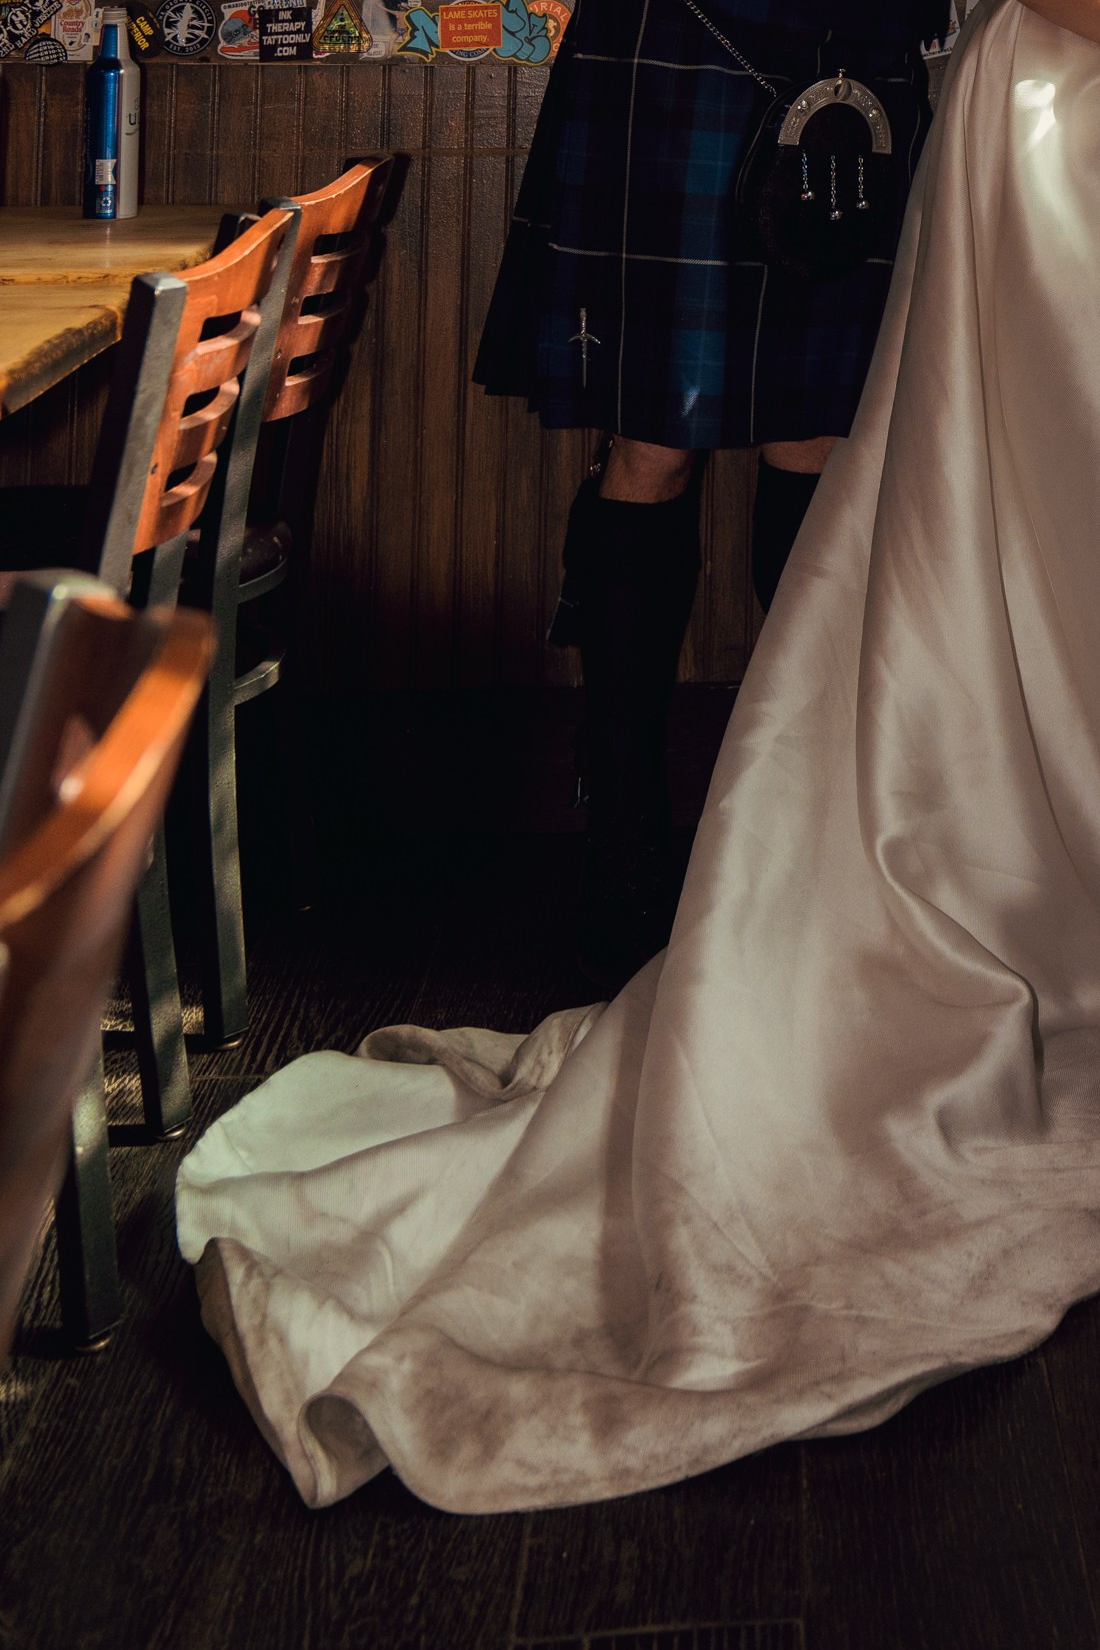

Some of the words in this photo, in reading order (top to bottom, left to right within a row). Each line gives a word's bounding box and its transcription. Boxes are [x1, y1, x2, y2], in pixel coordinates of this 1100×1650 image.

[278, 10, 292, 20] INK
[443, 10, 466, 20] LAME
[468, 9, 498, 19] SKATES
[59, 20, 85, 29] Country
[136, 16, 154, 37] CAMP
[266, 20, 306, 33] THERAPY
[449, 23, 455, 31] is
[464, 21, 493, 30] terrible
[62, 26, 83, 34] Roads
[262, 33, 312, 44] TATTOONLV
[452, 34, 490, 44] company.
[274, 45, 297, 57] .COM
